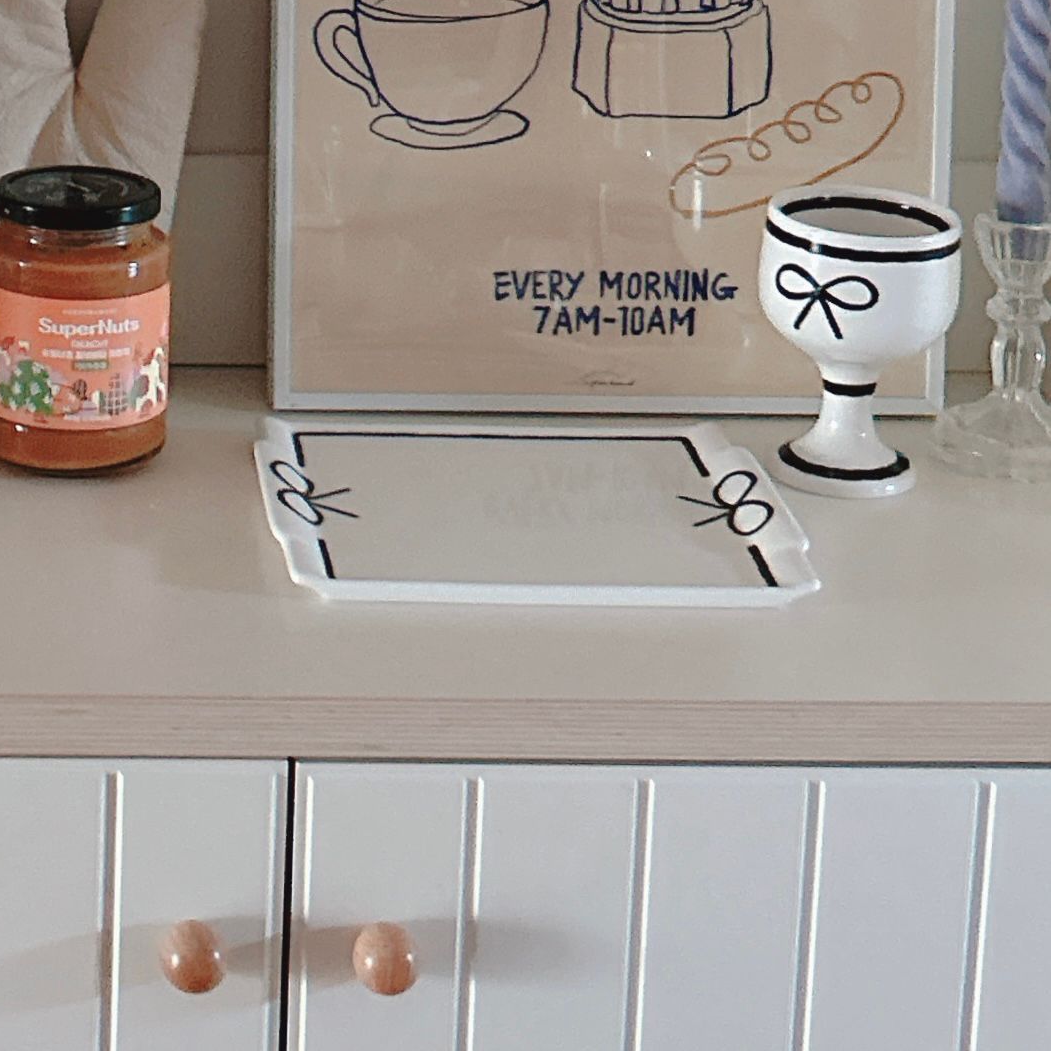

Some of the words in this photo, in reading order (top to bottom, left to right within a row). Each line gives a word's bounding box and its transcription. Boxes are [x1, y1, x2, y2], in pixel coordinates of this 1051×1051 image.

[493, 270, 585, 300] EVERY
[600, 268, 738, 301] MORNING
[38, 316, 140, 339] SuperNuts
[532, 305, 696, 336] 7AM-10AM
